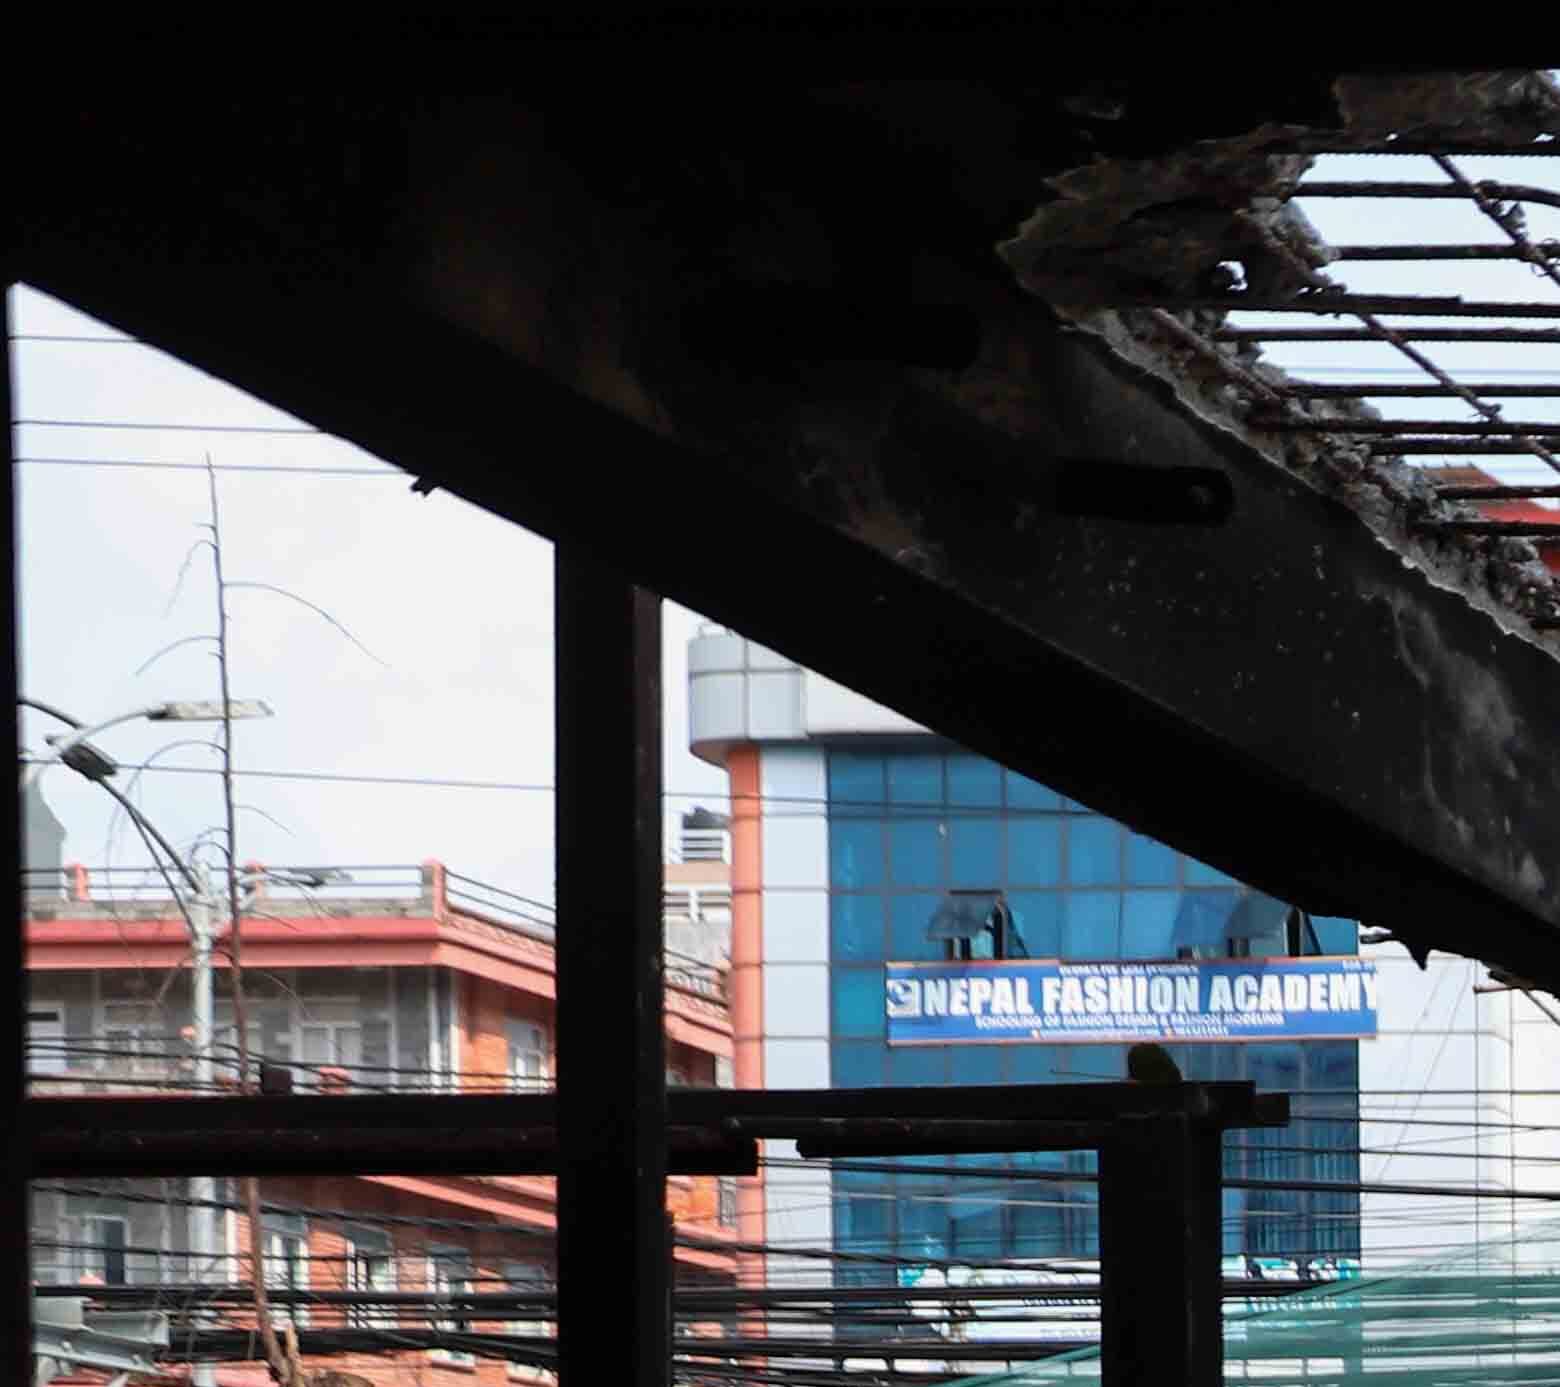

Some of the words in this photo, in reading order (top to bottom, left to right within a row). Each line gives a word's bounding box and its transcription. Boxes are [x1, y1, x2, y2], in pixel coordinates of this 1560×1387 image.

[923, 977, 1034, 1017] NEPAL
[1042, 974, 1199, 1015] FASHION
[1208, 973, 1377, 1012] ACADEMY
